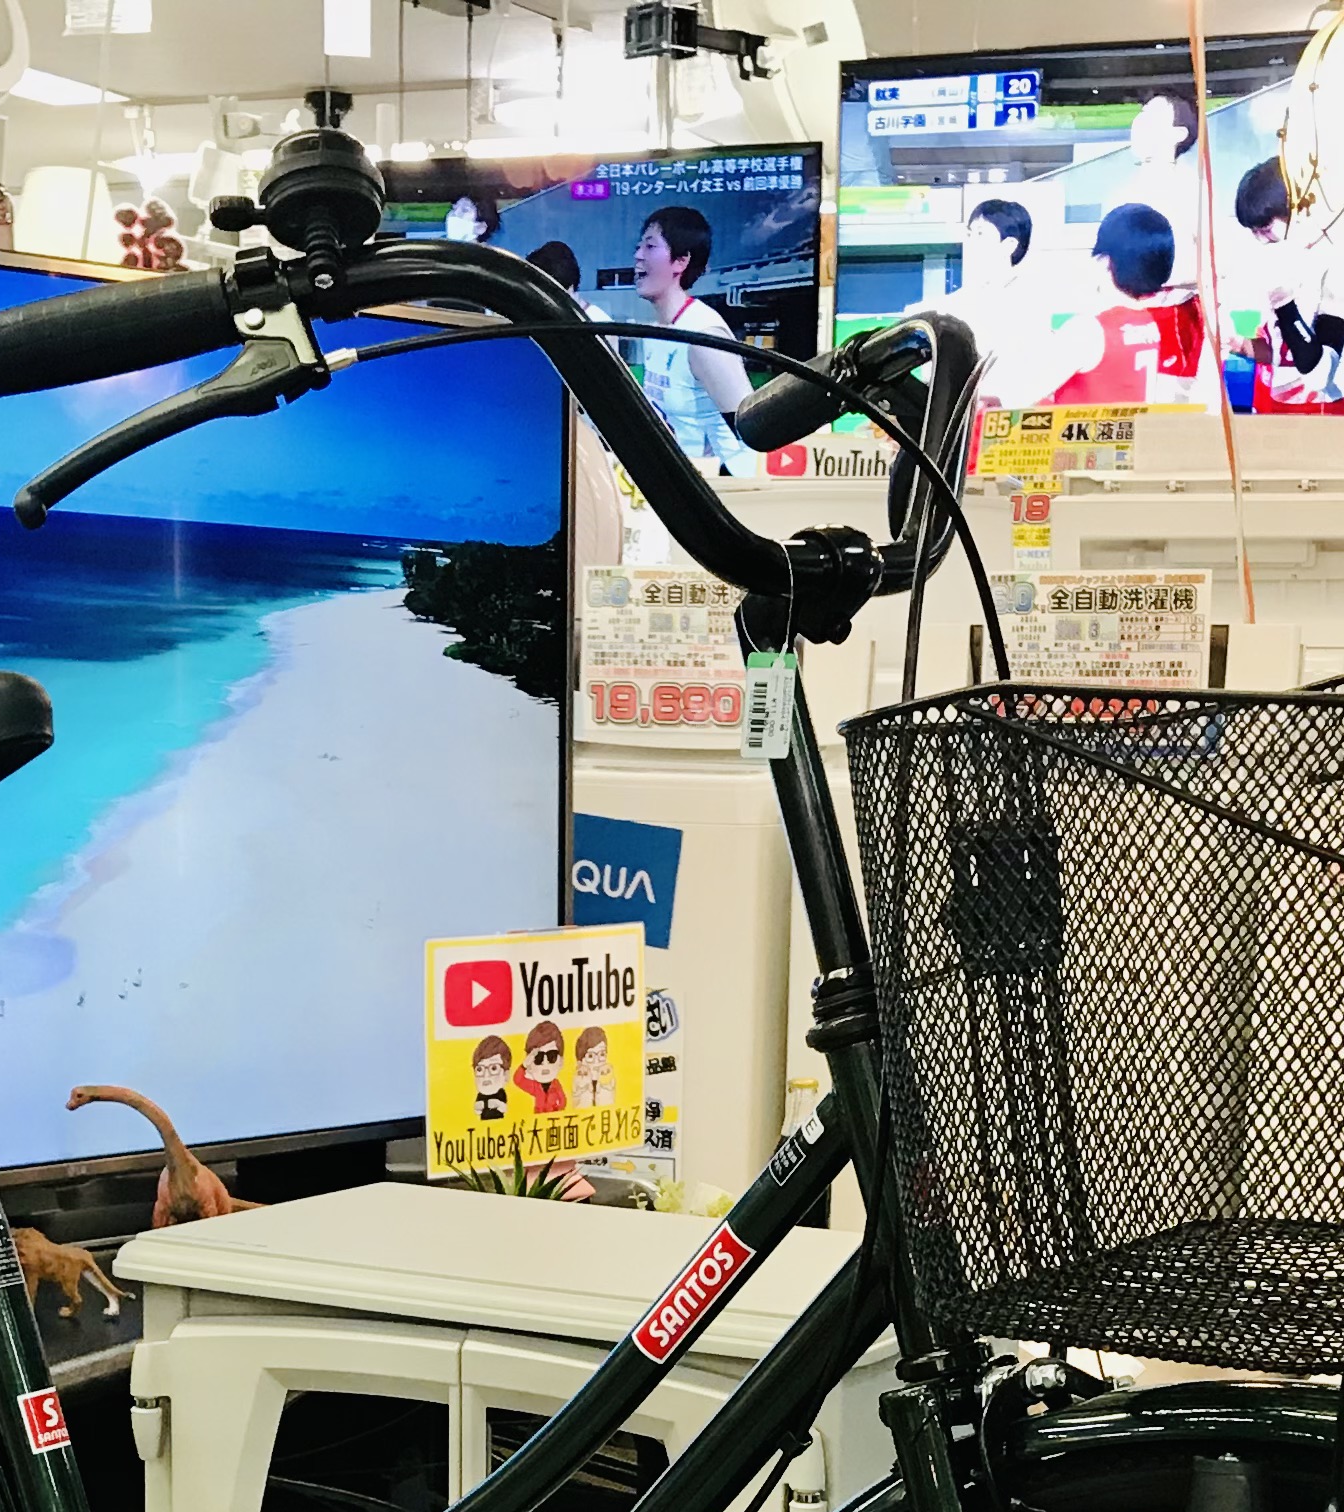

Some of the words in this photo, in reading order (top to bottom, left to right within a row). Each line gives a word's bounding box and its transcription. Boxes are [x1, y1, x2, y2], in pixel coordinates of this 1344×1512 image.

[1008, 78, 1031, 95] 20
[875, 113, 926, 130] 古川学園
[1007, 107, 1028, 124] 21
[596, 156, 803, 179] 全日本バレーボール高等学校選手権
[727, 180, 742, 191] vs
[984, 411, 1012, 438] 65
[1022, 415, 1052, 427] 4K
[1020, 433, 1051, 444] HDR
[1061, 422, 1090, 441] 4K
[1096, 421, 1134, 441] 液晶
[1010, 493, 1051, 523] 19
[1050, 587, 1196, 611] 全自動洗濯機
[589, 682, 742, 727] 19,690
[519, 952, 636, 1018] YouTube
[433, 1105, 642, 1165] YouTubeが大画面で見れる
[648, 1241, 735, 1349] SANTOS
[42, 1397, 59, 1428] S
